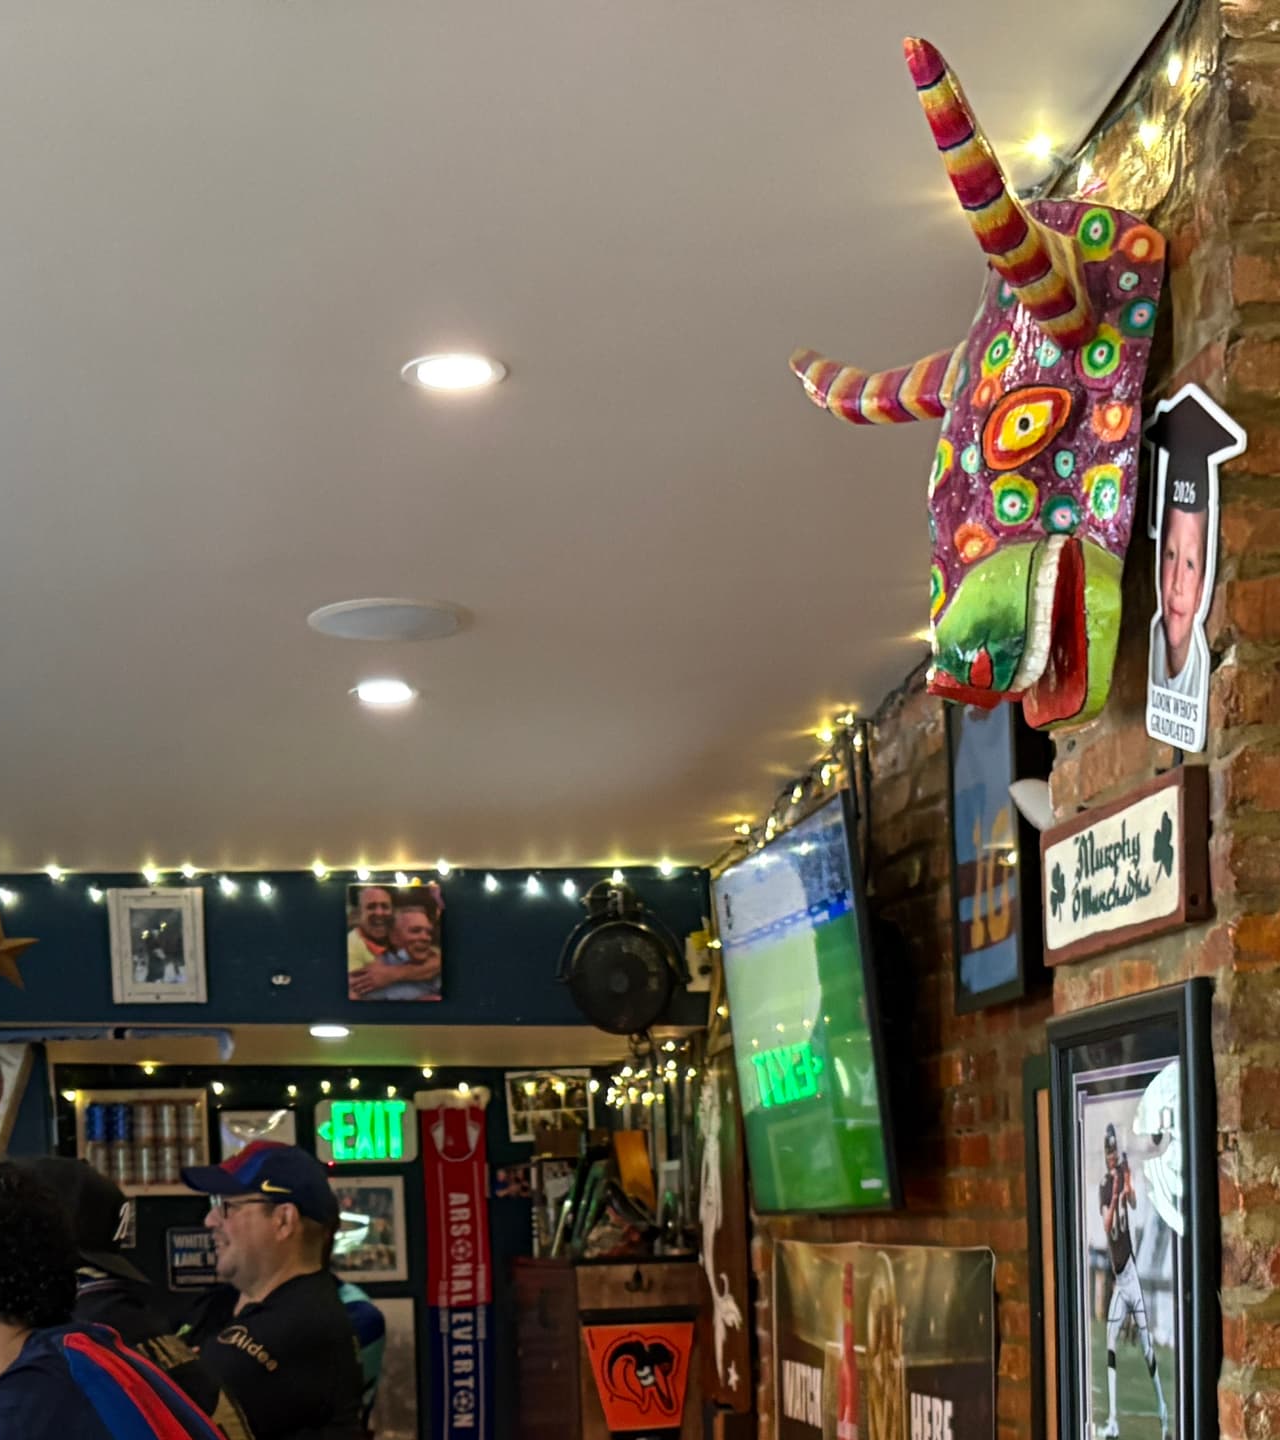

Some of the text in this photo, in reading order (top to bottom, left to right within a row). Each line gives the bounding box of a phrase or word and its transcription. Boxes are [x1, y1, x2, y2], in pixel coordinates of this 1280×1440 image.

[1173, 481, 1196, 504] 2026
[1151, 713, 1195, 745] GRADUATED
[1074, 819, 1141, 881] Murphy
[331, 1101, 406, 1160] EXIT
[782, 1360, 822, 1429] WATCH
